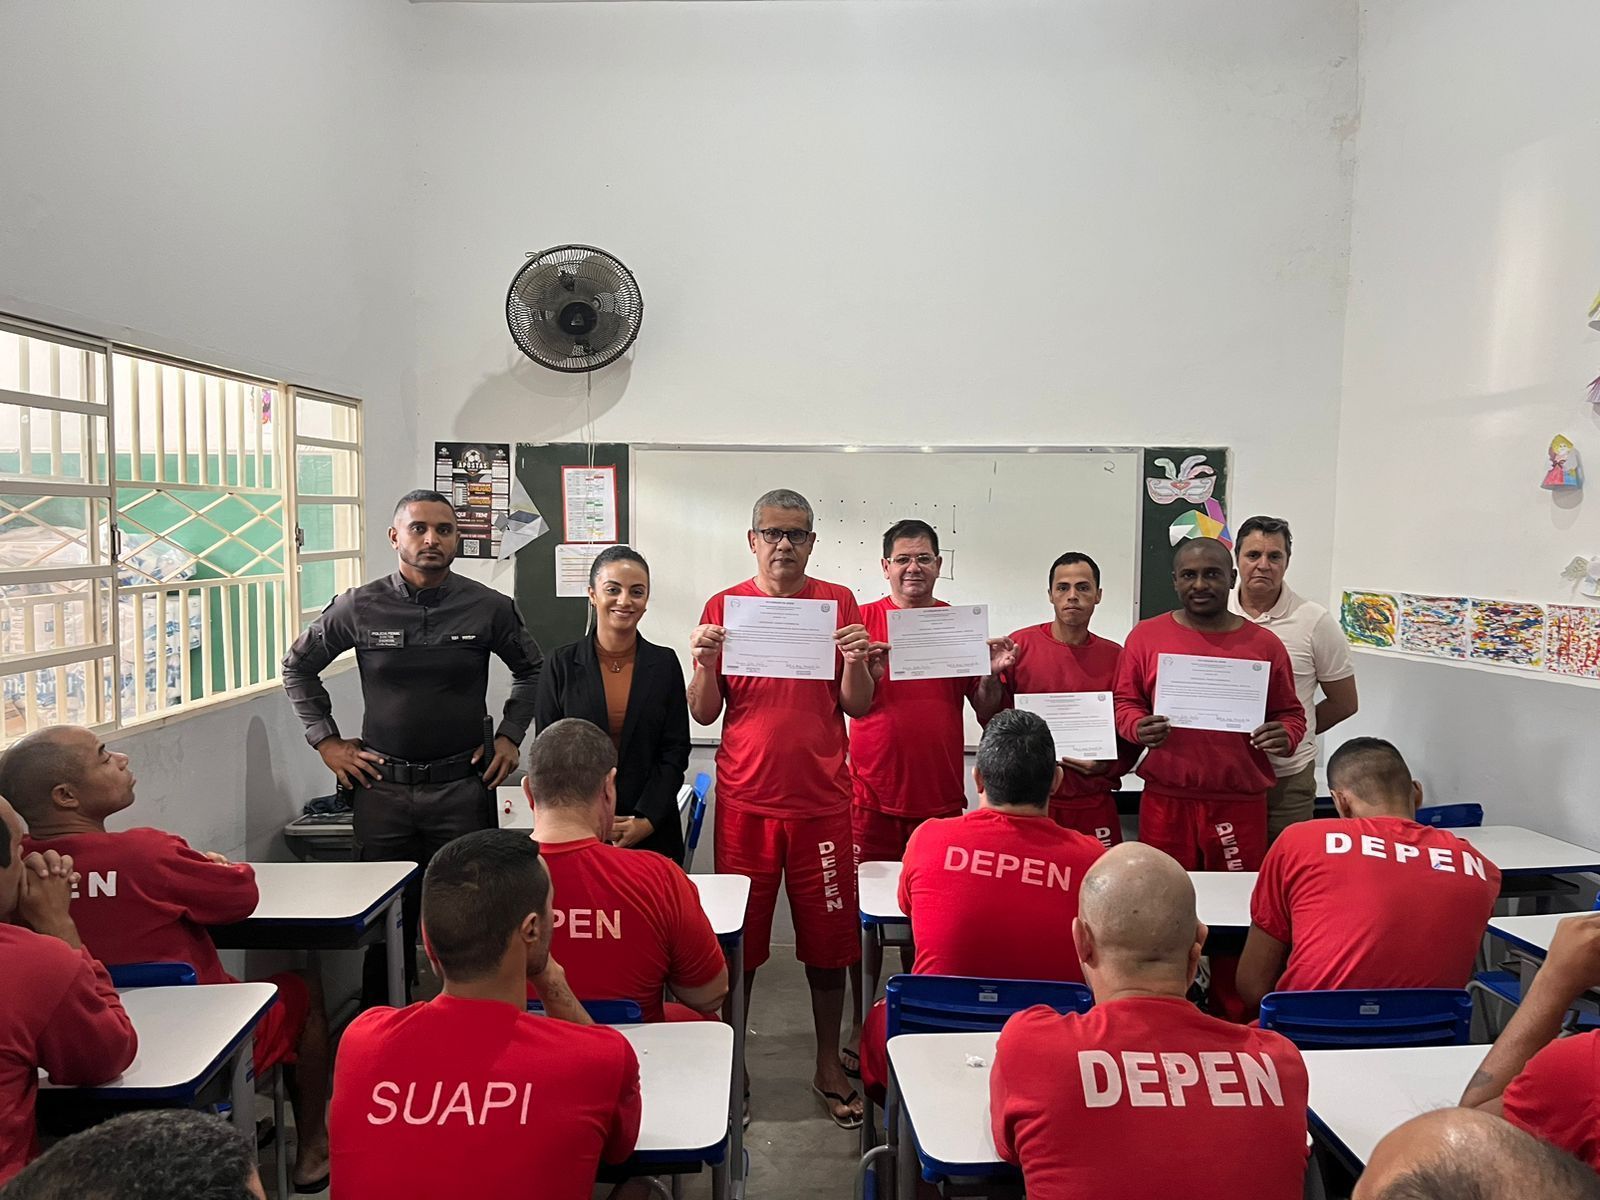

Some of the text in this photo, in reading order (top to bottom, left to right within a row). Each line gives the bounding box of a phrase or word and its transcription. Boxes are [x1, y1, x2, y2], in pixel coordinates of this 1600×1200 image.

[818, 840, 843, 912] DEPEN
[943, 846, 1071, 891] DEPEN
[1326, 832, 1487, 881] DEPEN
[367, 1081, 532, 1126] SUAPI
[1078, 1050, 1285, 1108] DEPEN
